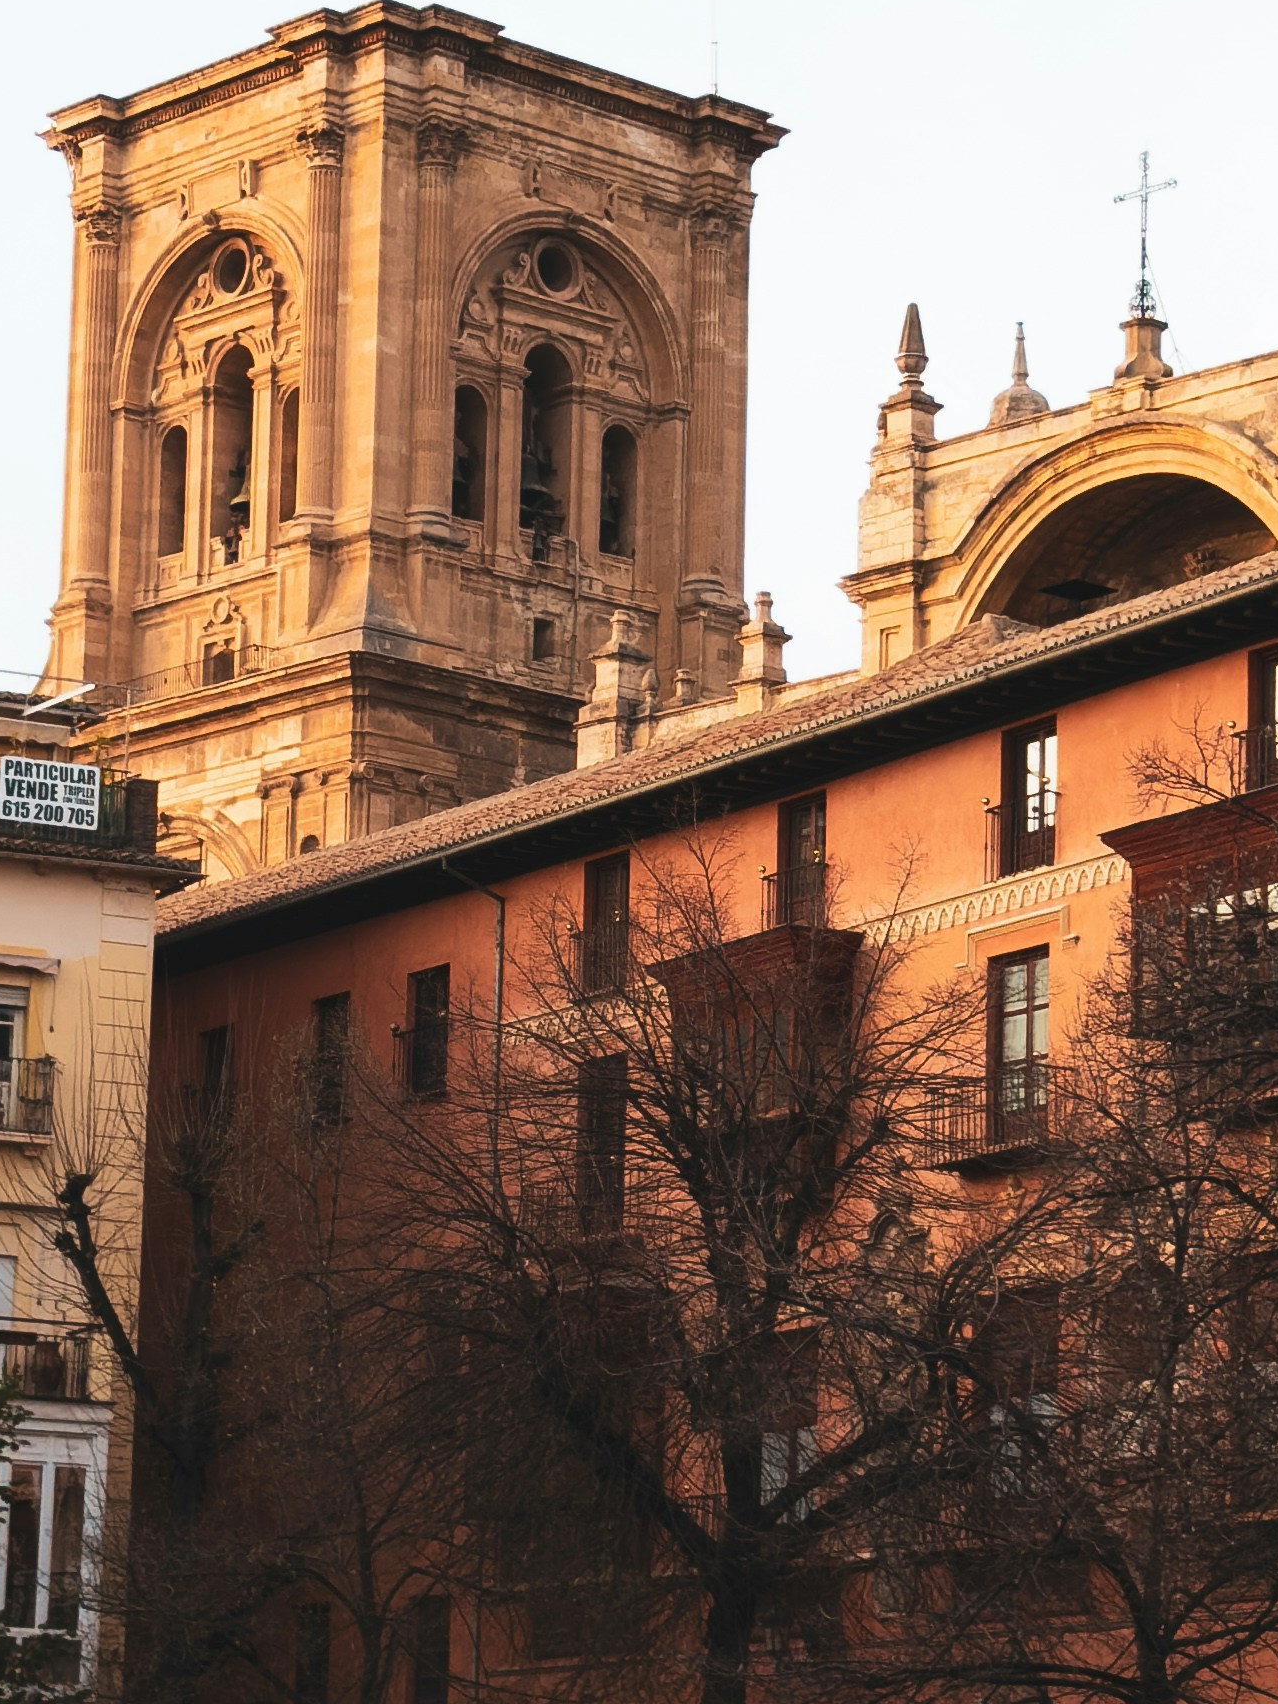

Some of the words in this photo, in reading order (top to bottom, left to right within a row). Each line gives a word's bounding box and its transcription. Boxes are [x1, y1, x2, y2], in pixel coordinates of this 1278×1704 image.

[5, 759, 96, 786] PARTICULAR
[5, 777, 58, 802] VENDE
[63, 785, 95, 799] TRIPLEX
[3, 800, 30, 819] 615
[34, 803, 64, 823] 200
[67, 807, 95, 827] 705
